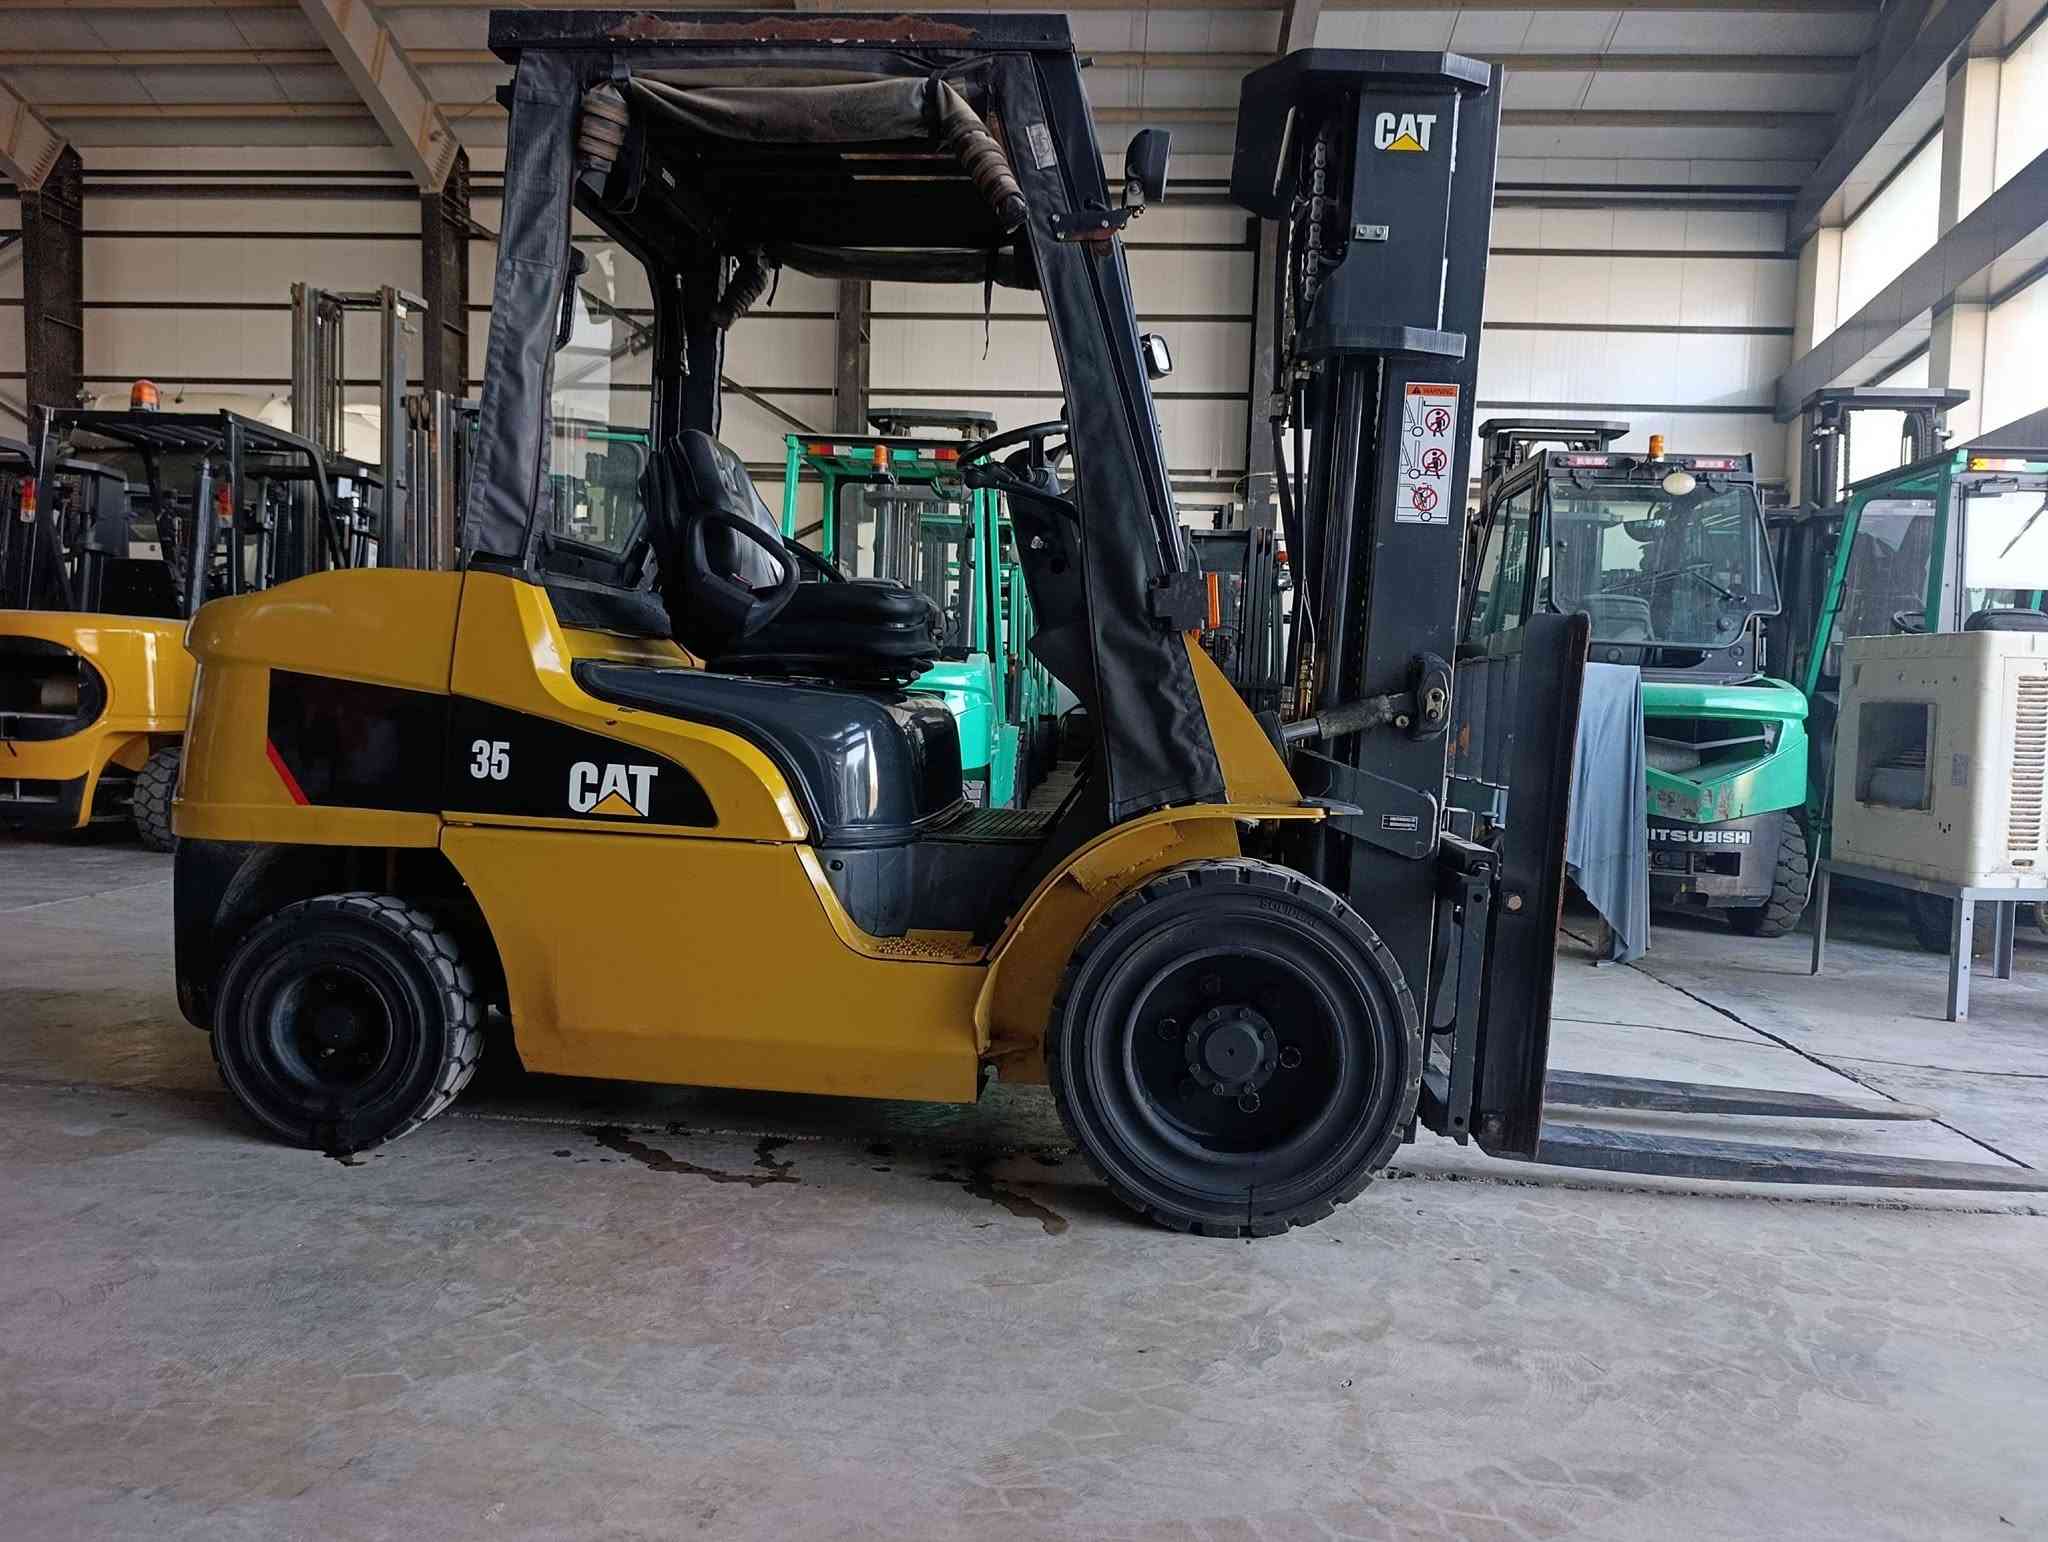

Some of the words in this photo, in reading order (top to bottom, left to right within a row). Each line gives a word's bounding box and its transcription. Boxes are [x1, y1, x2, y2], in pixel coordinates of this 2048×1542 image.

[1374, 112, 1437, 152] CAT
[470, 739, 510, 780] 35
[568, 761, 659, 817] CAT
[1647, 828, 1752, 844] ITSUBISHI
